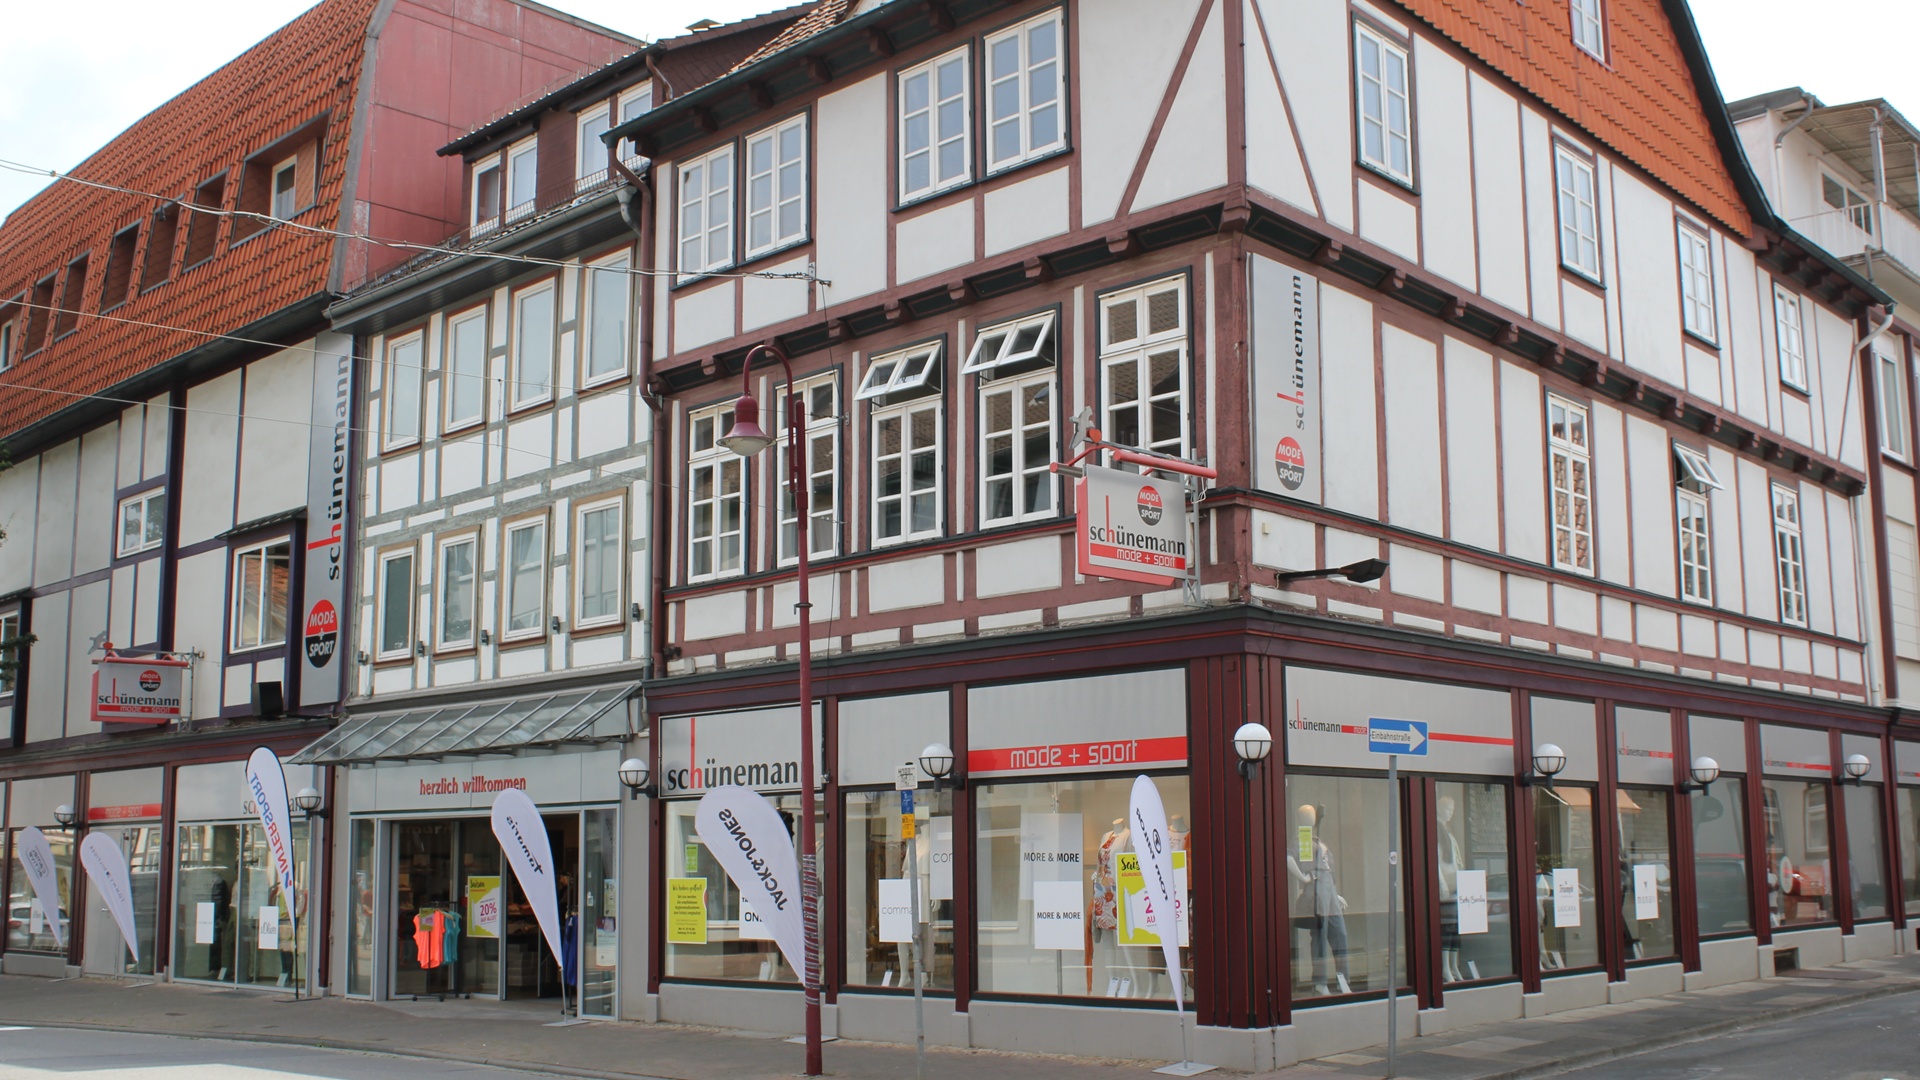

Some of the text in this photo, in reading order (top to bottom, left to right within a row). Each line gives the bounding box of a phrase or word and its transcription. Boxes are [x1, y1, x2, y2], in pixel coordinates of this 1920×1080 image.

[1277, 275, 1304, 430] schünemann
[1278, 444, 1301, 459] MODE
[308, 354, 349, 581] schünemann
[1279, 467, 1302, 484] SPORT
[1140, 491, 1159, 502] MODE
[1141, 508, 1160, 520] SPORT
[1090, 495, 1185, 555] schünemann
[1117, 548, 1142, 562] mode
[1154, 554, 1175, 568] sport
[309, 610, 335, 627] MODE
[309, 638, 335, 658] SPORT
[98, 678, 180, 706] schünemann
[1288, 699, 1341, 733] schünemann
[1371, 731, 1411, 742] Einbahnstraße
[667, 717, 802, 790] schüneman
[1010, 745, 1062, 768] mode
[1088, 740, 1138, 765] sport
[420, 775, 526, 795] herzlich willkommen
[1024, 852, 1079, 862] MORE & MORE
[1121, 857, 1140, 871] Sais
[480, 901, 497, 917] 20%
[1037, 911, 1081, 920] MORE & MORE
